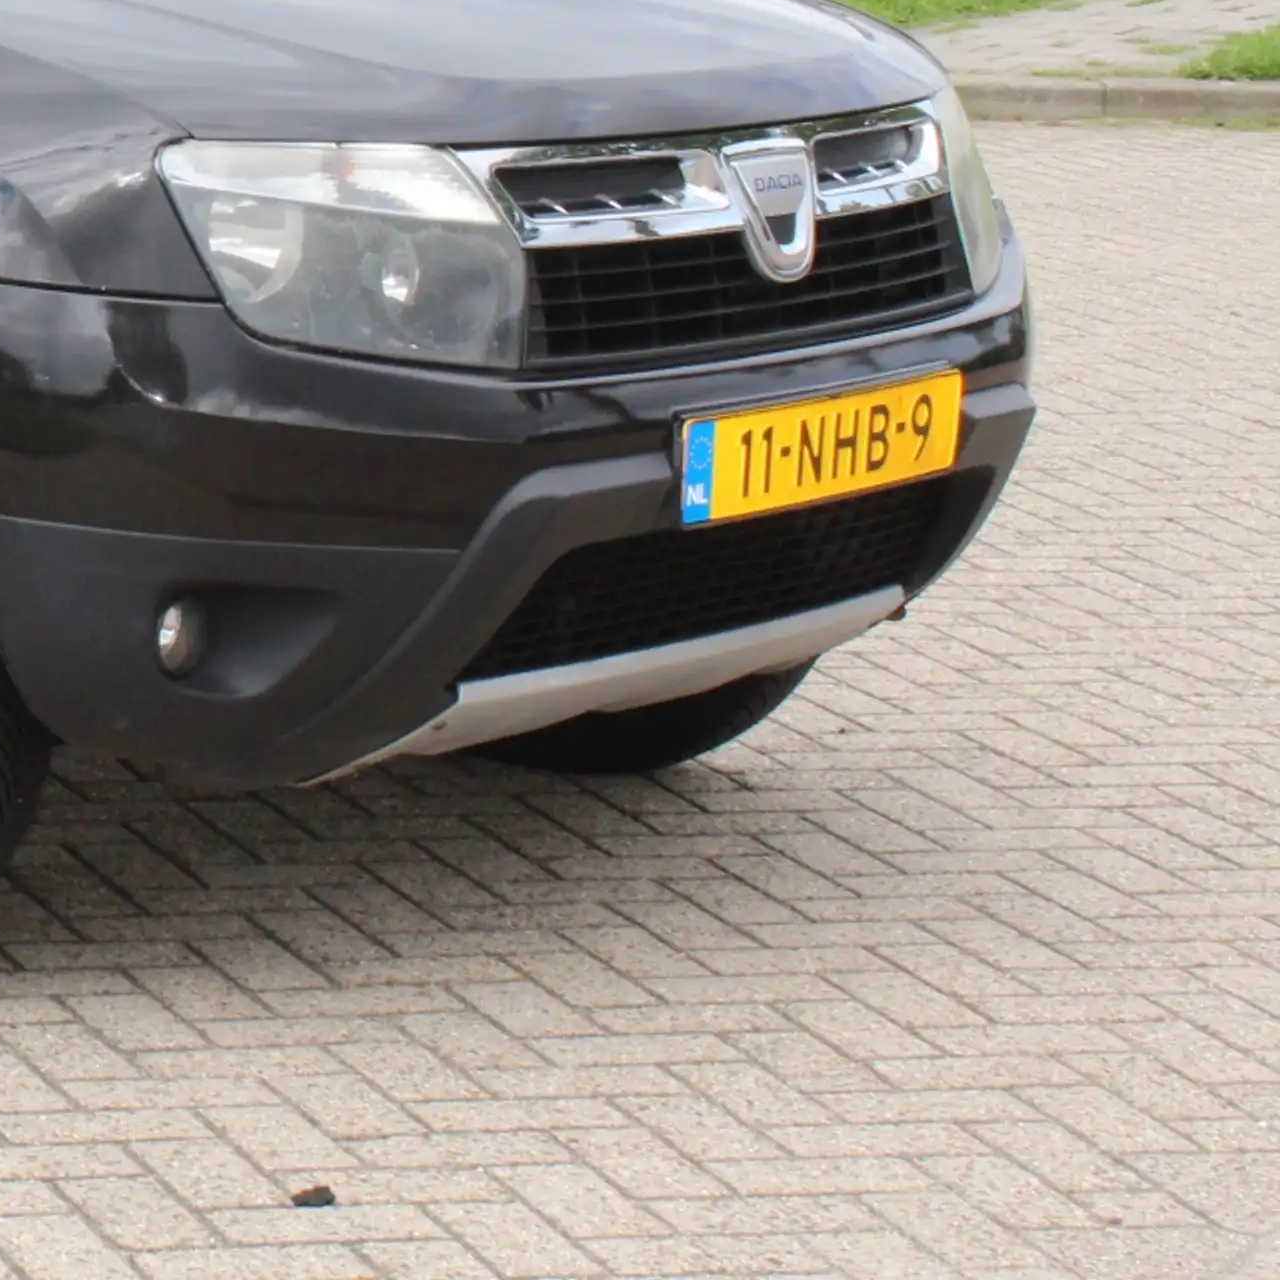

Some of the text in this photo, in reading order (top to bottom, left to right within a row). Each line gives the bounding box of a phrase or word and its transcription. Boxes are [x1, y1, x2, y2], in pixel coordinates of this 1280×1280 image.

[754, 173, 803, 192] DACIA
[741, 393, 933, 498] 11-NHB-9
[686, 483, 708, 505] NL
